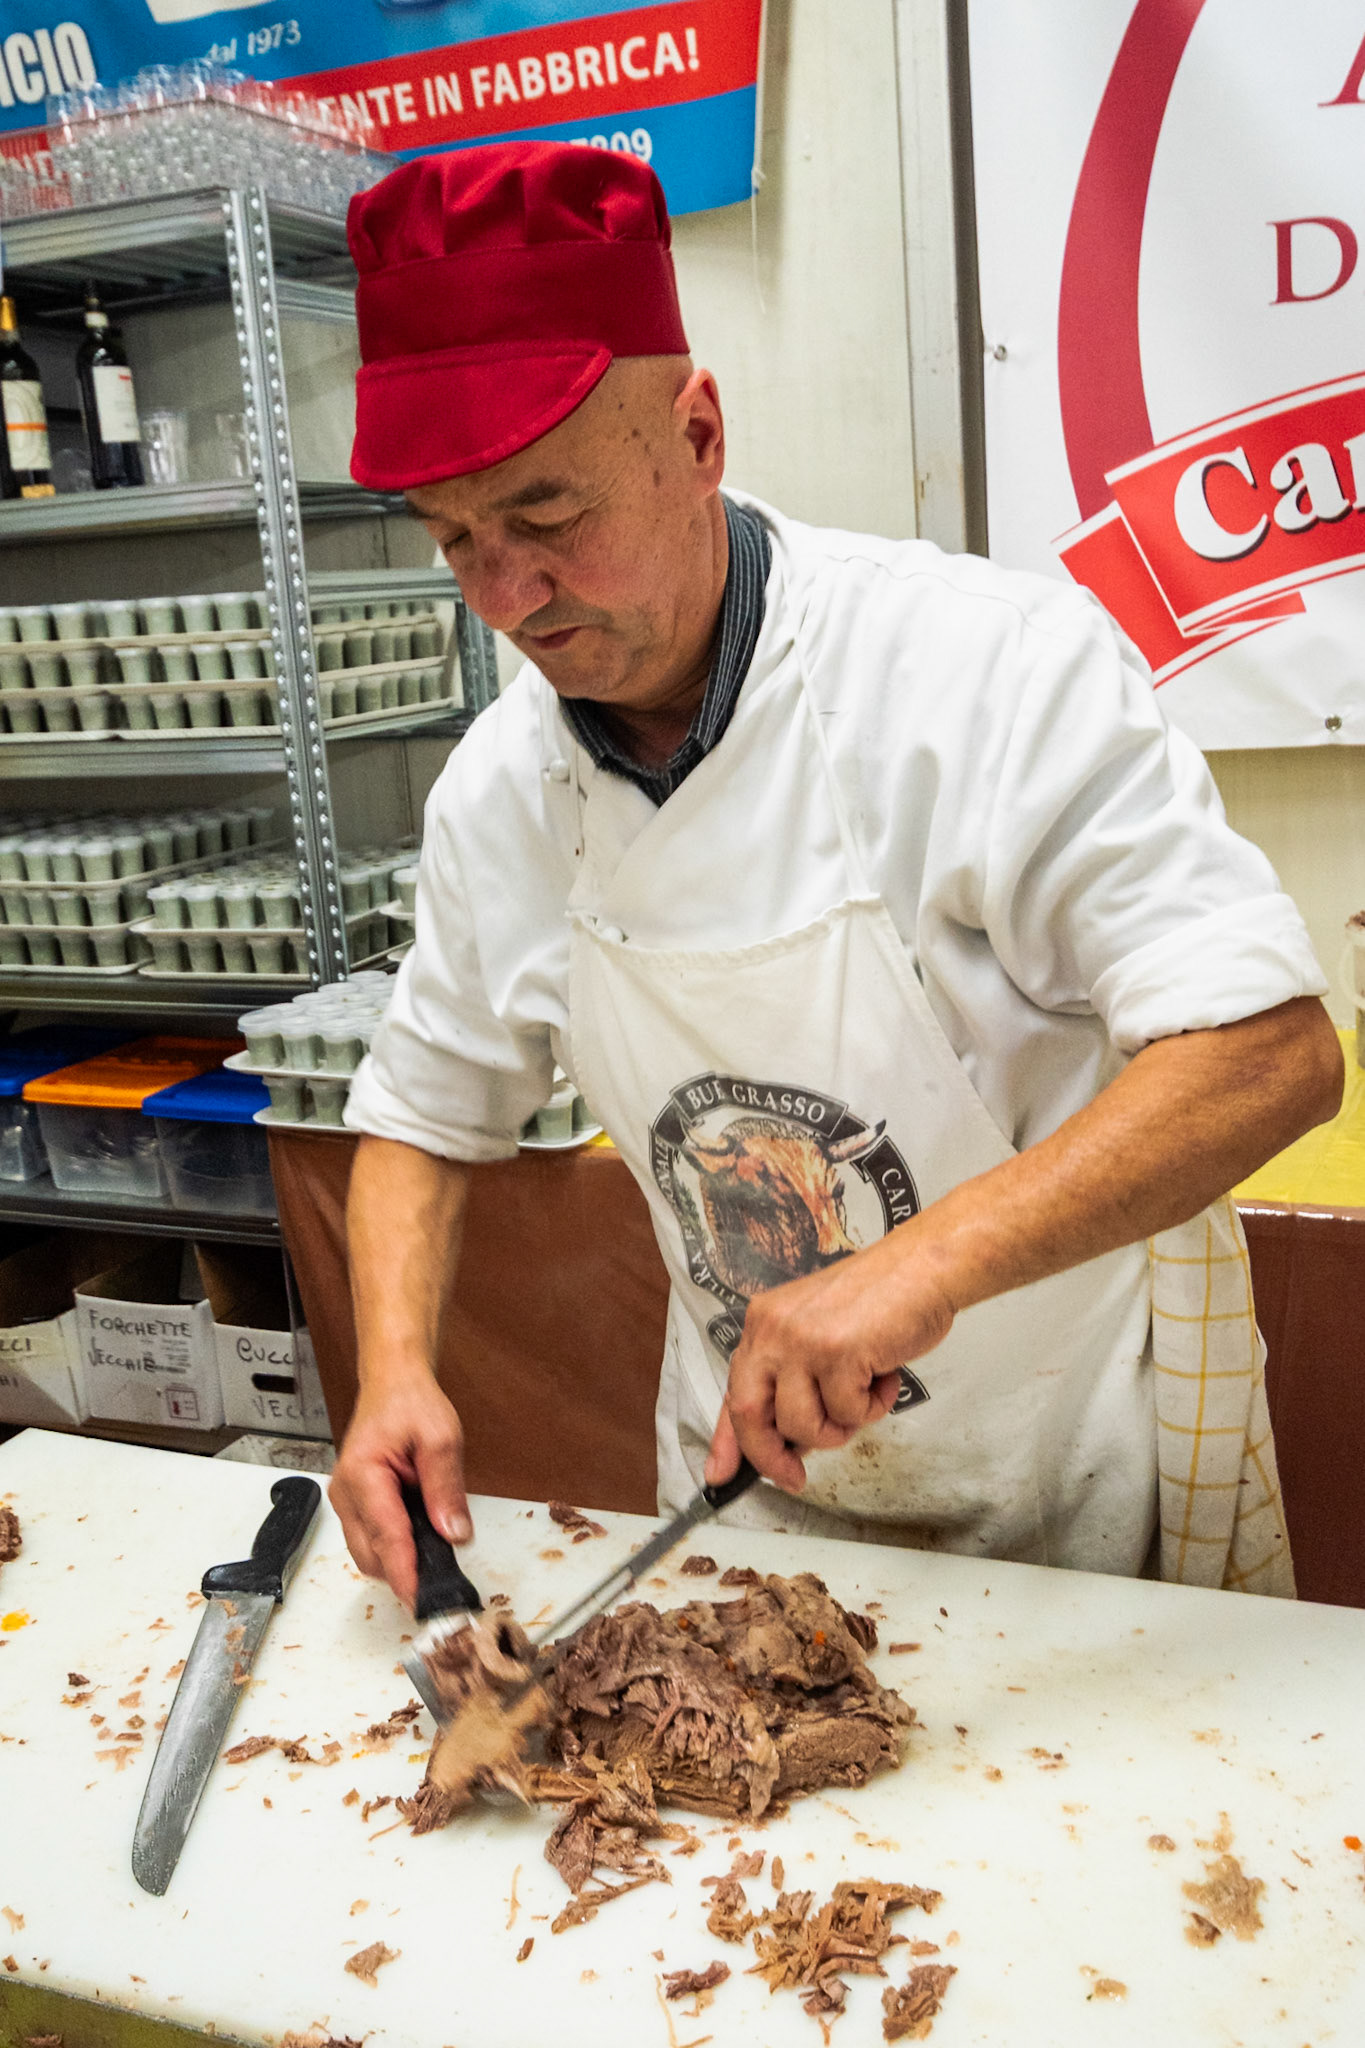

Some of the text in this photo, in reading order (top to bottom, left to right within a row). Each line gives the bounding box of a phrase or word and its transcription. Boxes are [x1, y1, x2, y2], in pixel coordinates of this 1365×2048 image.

[247, 19, 301, 56] 1973
[0, 22, 97, 107] CIO
[423, 72, 463, 118] IN
[470, 27, 700, 110] FABBRICA!
[686, 1080, 826, 1123] BUE GRASSO
[881, 1168, 912, 1228] CAR
[89, 1308, 192, 1338] FORCHETTE
